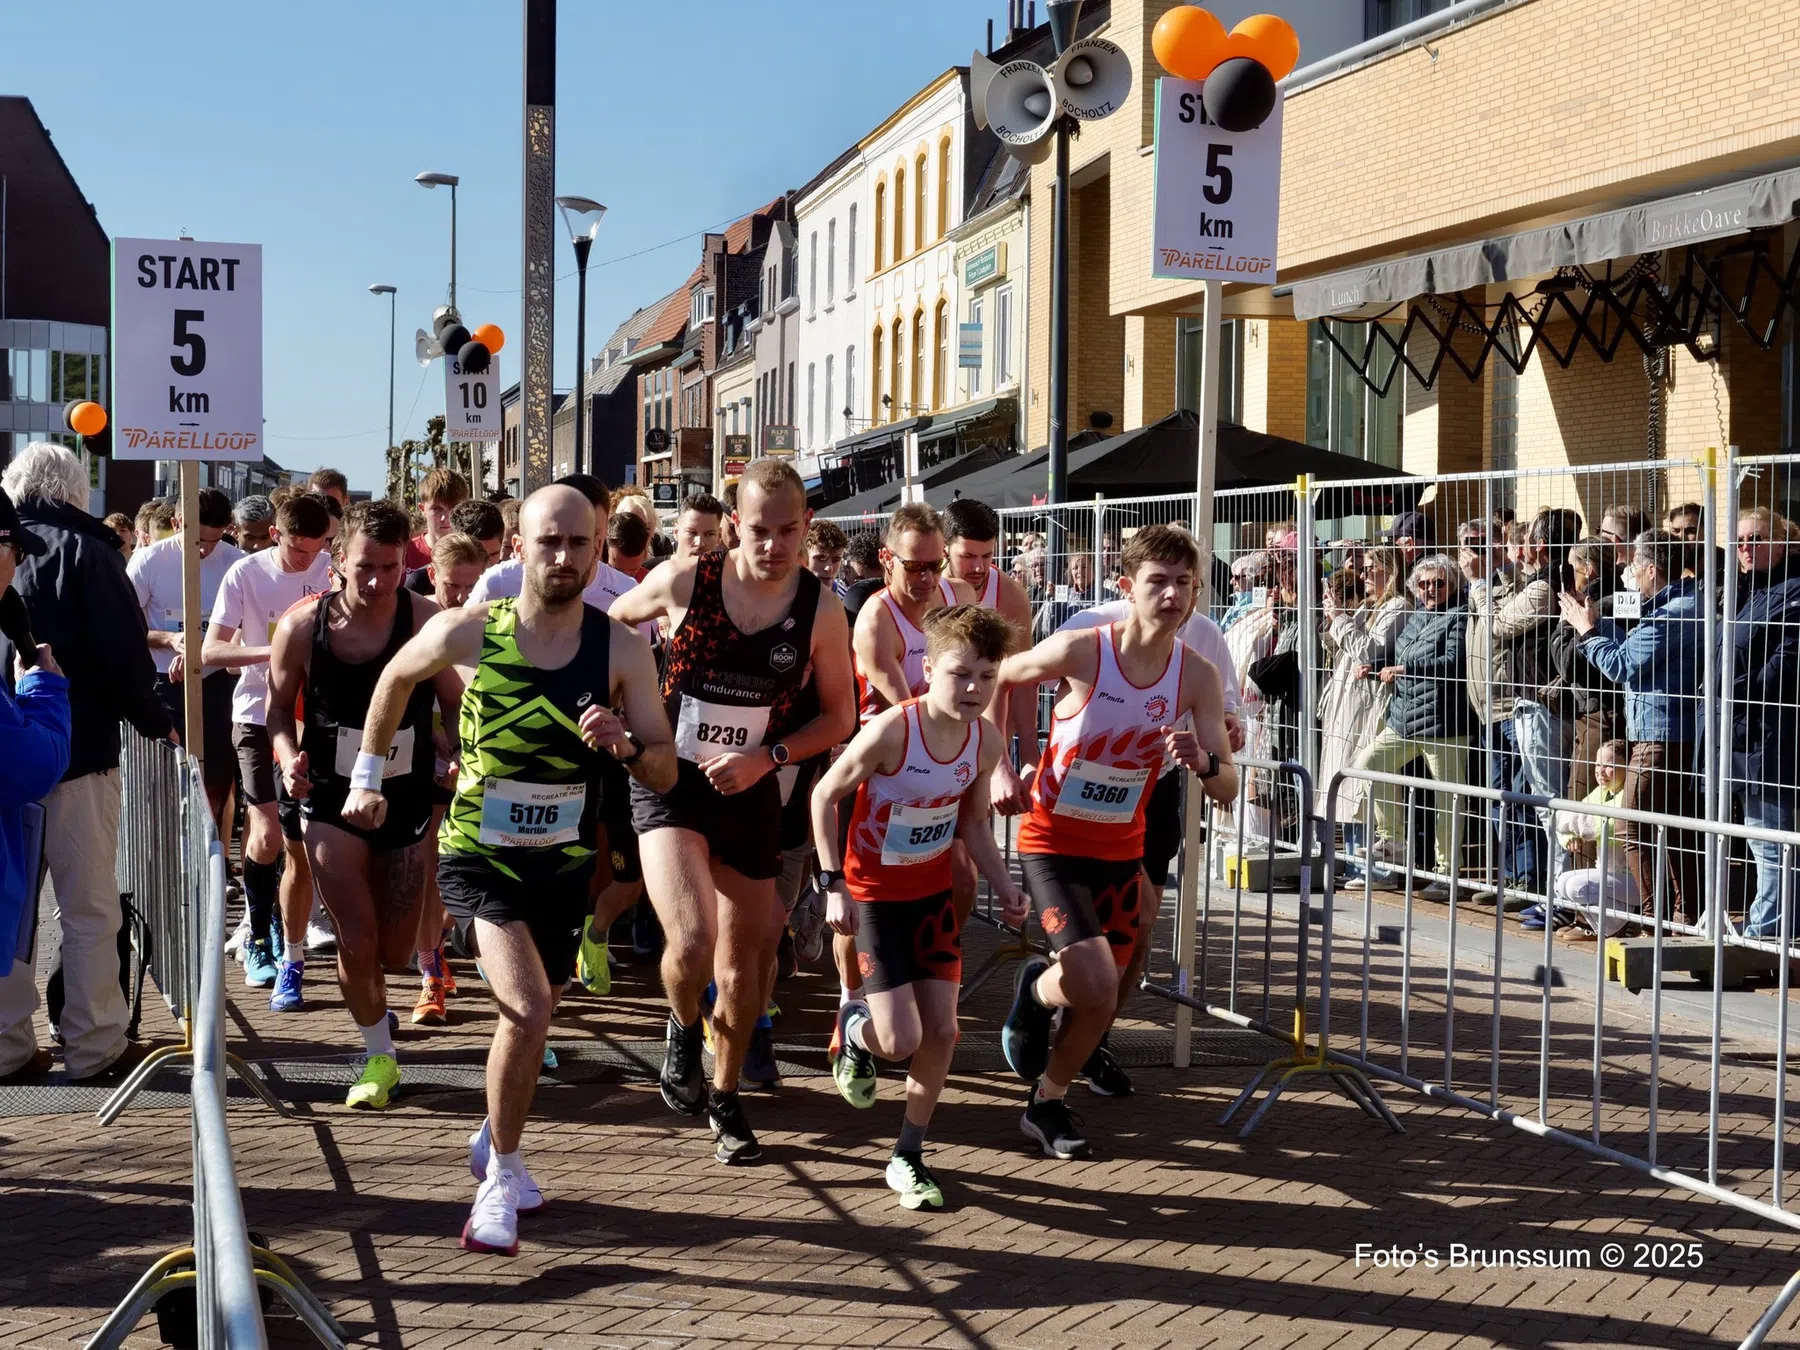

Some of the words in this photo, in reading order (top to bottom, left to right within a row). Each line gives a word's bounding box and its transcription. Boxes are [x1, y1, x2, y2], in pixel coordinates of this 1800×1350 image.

[1071, 39, 1118, 55] FRANZEN
[1000, 62, 1044, 78] FRANZEN
[1061, 98, 1114, 119] BOCHOLTZ
[995, 125, 1045, 143] BOCHOLTZ
[1202, 143, 1233, 205] 5
[1199, 212, 1233, 239] km
[137, 254, 240, 292] START
[1331, 284, 1360, 306] Lunch
[170, 309, 207, 376] 5
[169, 385, 209, 413] km
[459, 382, 487, 409] 10
[466, 412, 482, 423] km
[703, 683, 761, 700] endurance
[697, 722, 748, 746] 8239
[532, 792, 568, 800] RECREATIE
[1081, 781, 1129, 804] 5360
[510, 802, 559, 825] 5176
[517, 825, 548, 835] Martijn
[909, 820, 952, 845] 5287
